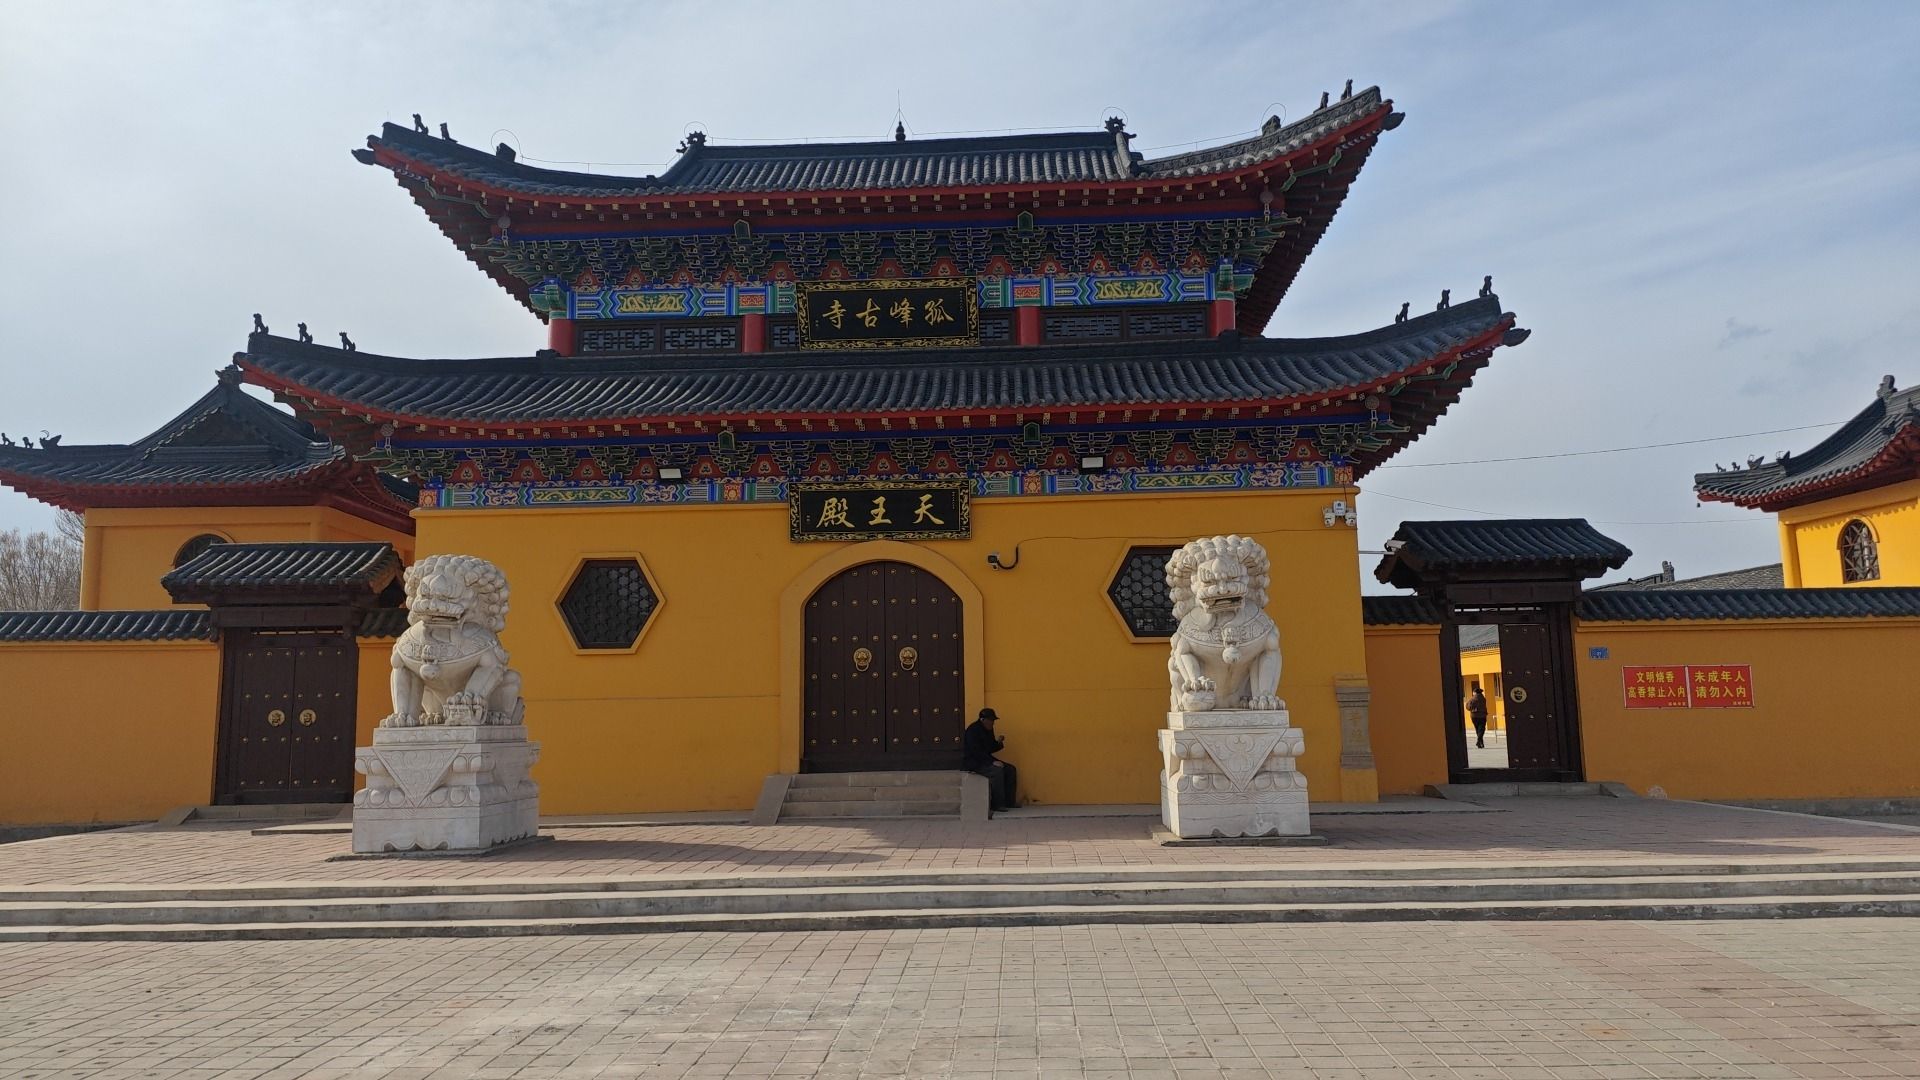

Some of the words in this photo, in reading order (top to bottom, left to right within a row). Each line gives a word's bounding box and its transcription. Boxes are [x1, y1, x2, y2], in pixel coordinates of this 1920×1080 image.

[816, 493, 945, 529] 天王殿
[1636, 671, 1675, 683] 文明烧香
[1694, 670, 1746, 683] 未成年人
[1627, 686, 1686, 699] 高香禁止入内
[1696, 686, 1747, 699] 请勿入内
